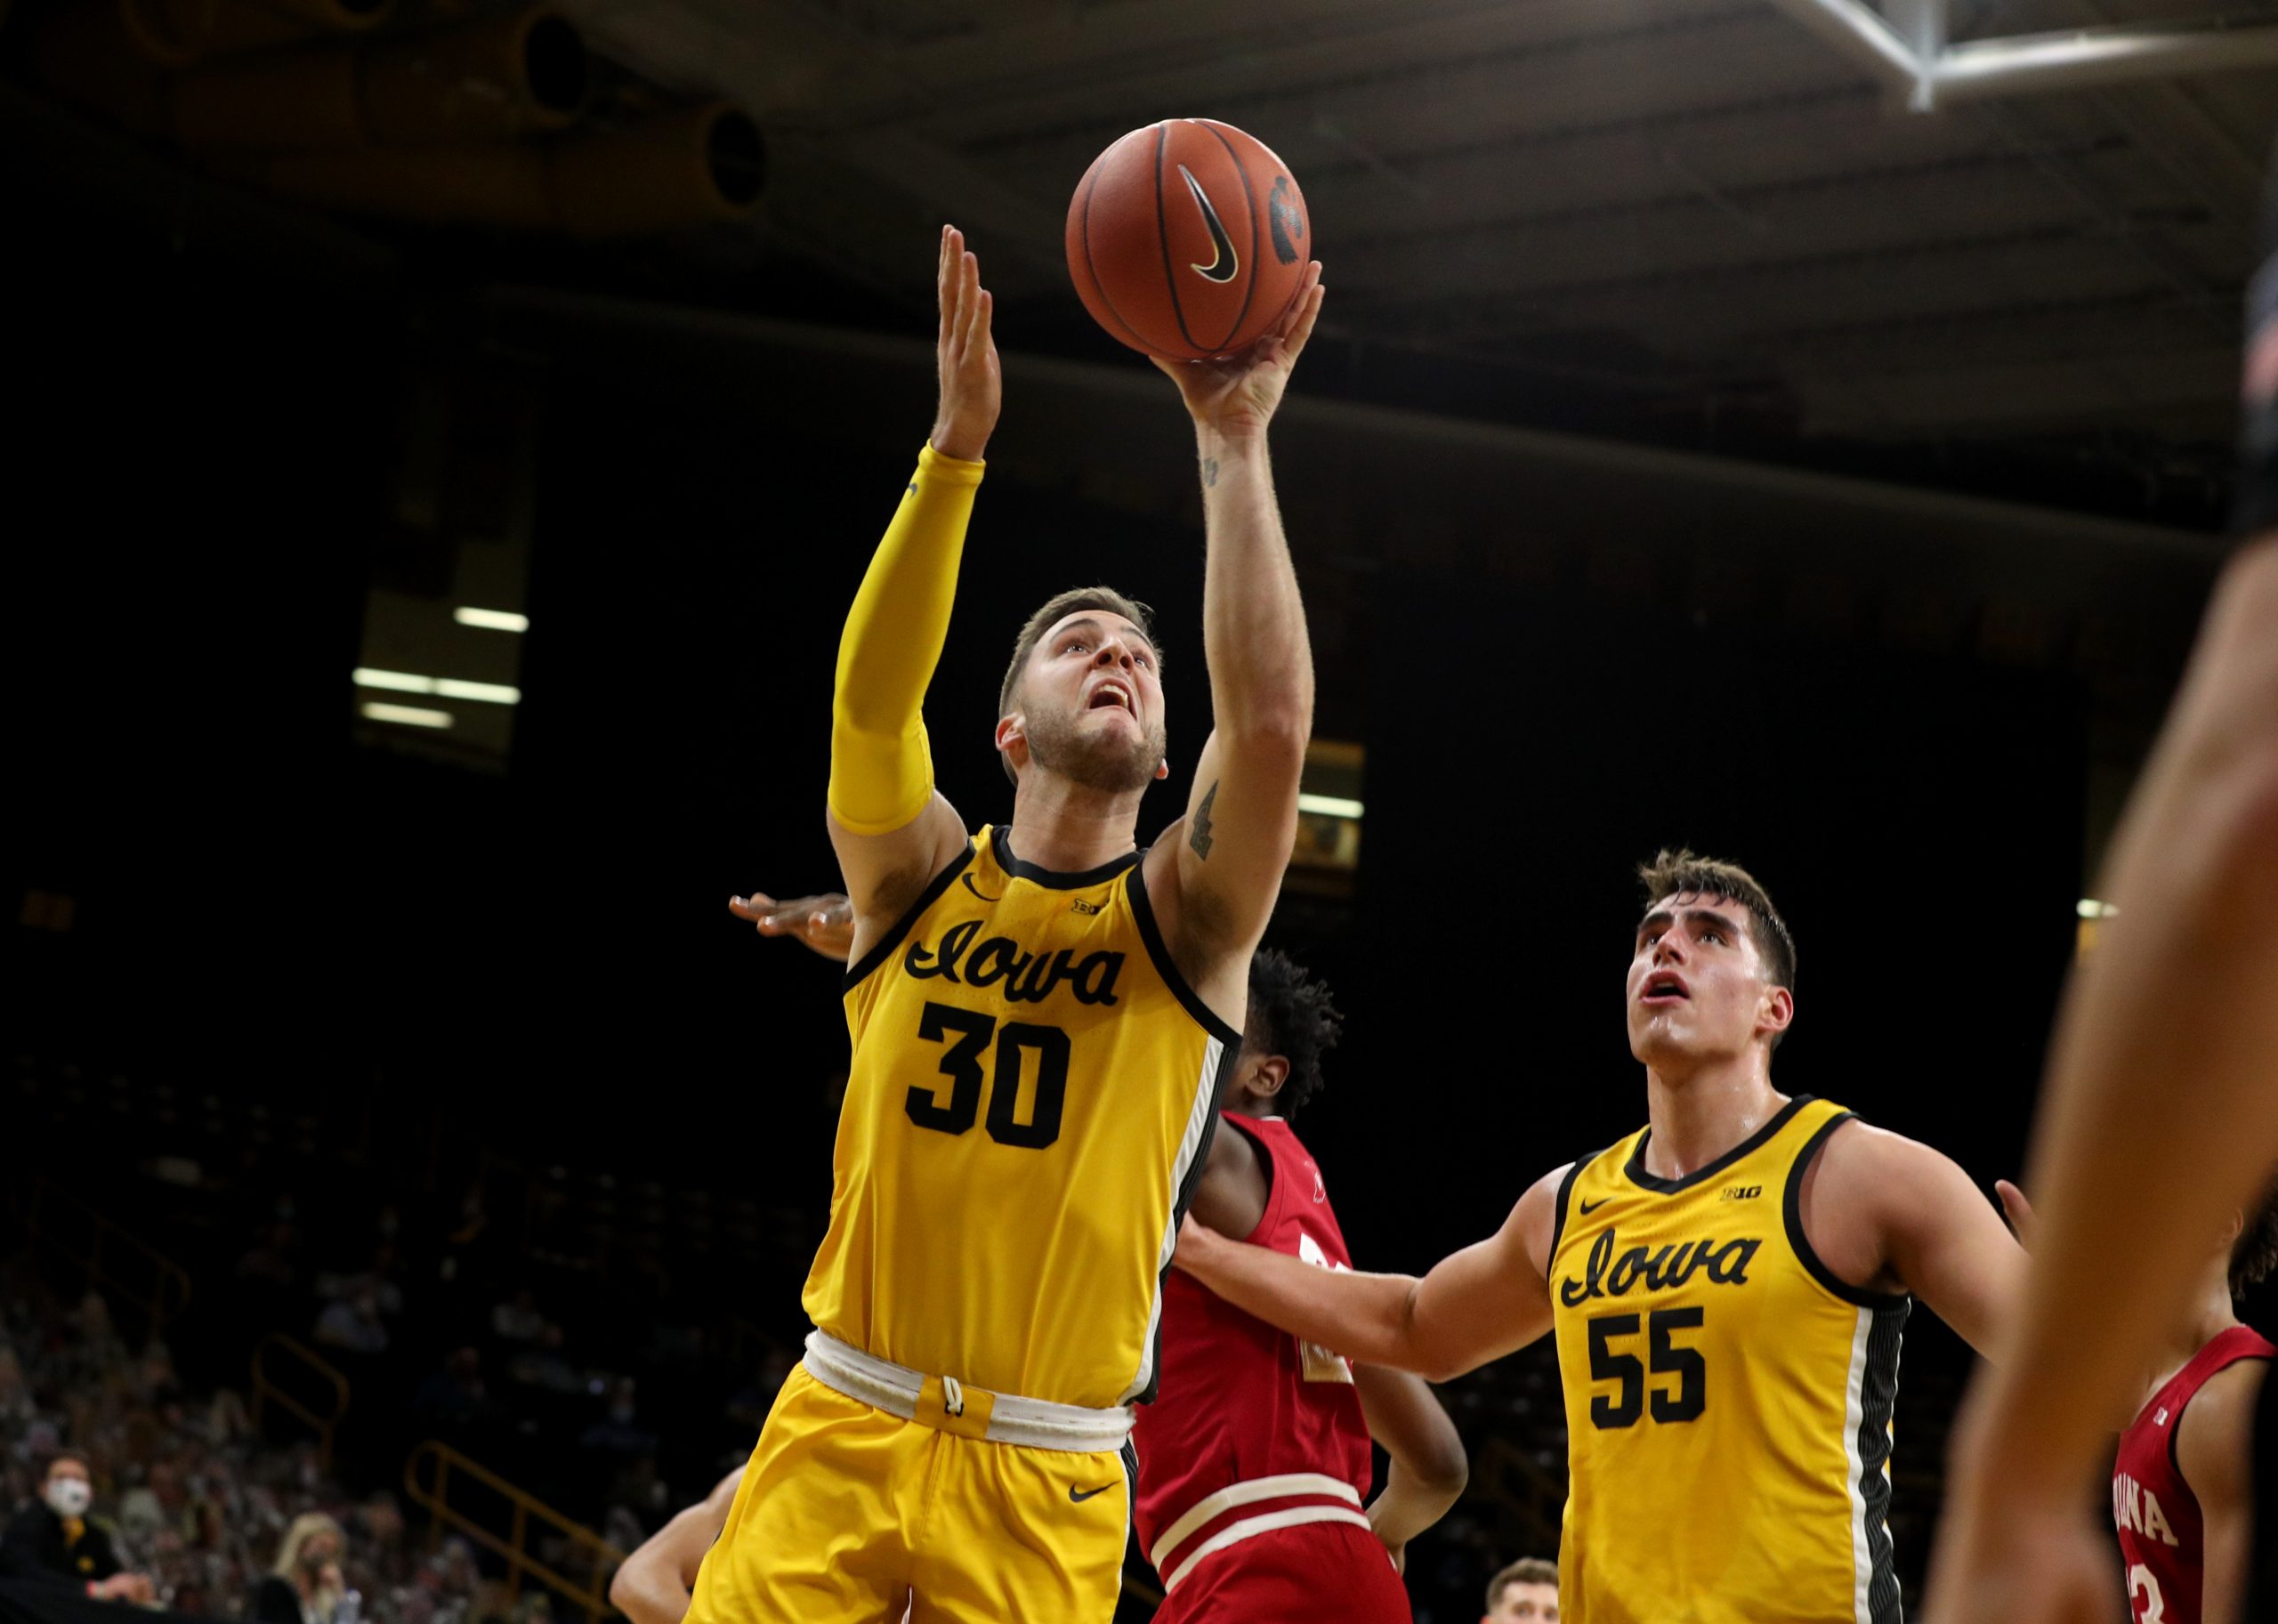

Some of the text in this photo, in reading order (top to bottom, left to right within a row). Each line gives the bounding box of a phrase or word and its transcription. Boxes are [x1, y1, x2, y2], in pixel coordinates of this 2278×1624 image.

[904, 920, 1126, 1006] Iowa
[905, 1001, 1071, 1150] 30
[1561, 1228, 1762, 1307] Iowa
[1587, 1306, 1706, 1430] 55
